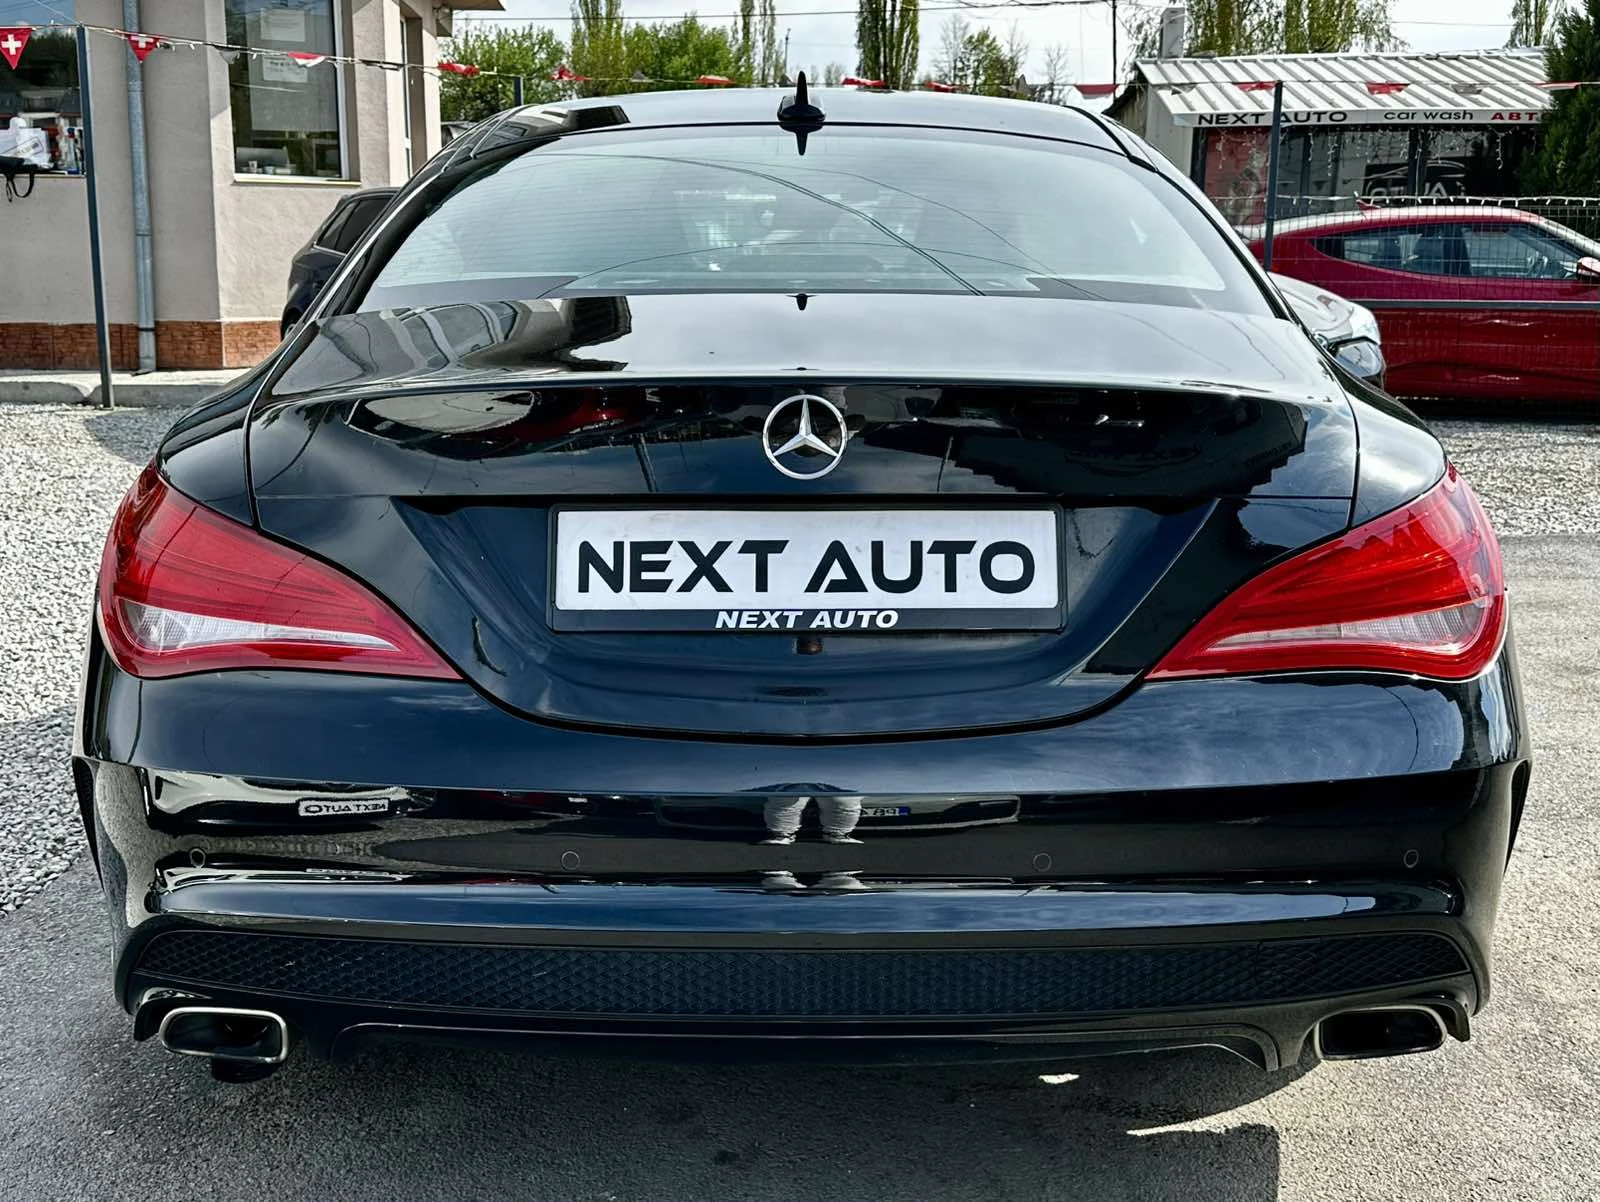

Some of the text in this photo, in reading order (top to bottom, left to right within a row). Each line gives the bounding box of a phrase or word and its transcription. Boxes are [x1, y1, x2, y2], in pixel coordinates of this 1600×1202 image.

[1198, 111, 1348, 125] NEXT AUTO
[1383, 110, 1473, 120] car wash
[578, 540, 1035, 593] NEXT AUTO
[715, 610, 899, 628] NEXT AUTO
